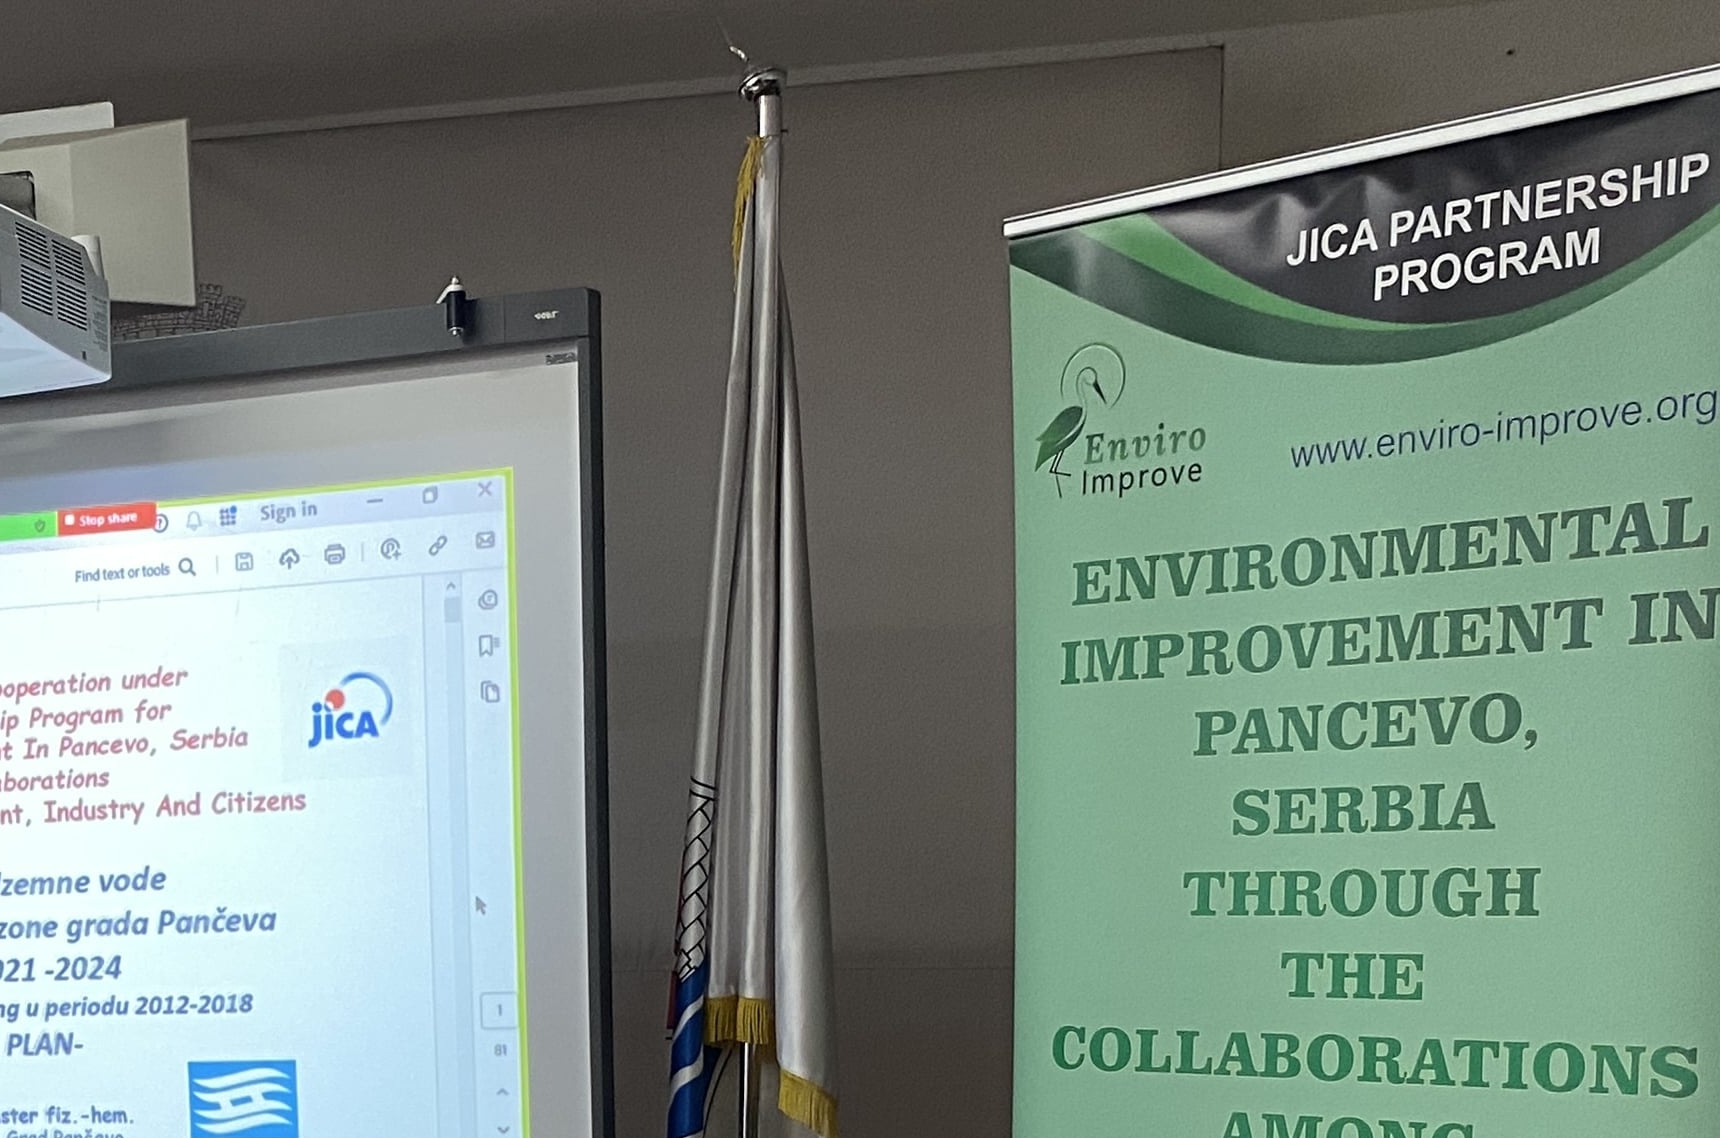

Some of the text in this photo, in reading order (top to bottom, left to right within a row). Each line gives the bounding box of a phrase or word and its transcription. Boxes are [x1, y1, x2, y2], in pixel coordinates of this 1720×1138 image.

[1286, 152, 1711, 267] JICA PARTNERSHIP
[1373, 227, 1601, 301] PROGRAM
[1083, 424, 1207, 467] Enviro
[1291, 388, 1719, 469] www.enviro-improve.org
[1081, 460, 1204, 498] Improve
[79, 511, 138, 528] Stop share
[260, 501, 318, 525] Sign in
[1071, 496, 1710, 606] ENVIRONMENTAL
[75, 563, 170, 583] Find text or tools
[1059, 588, 1720, 685] IMPROVEMENT IN
[121, 665, 188, 690] under
[29, 706, 123, 734] Program
[135, 699, 172, 724] for
[1192, 691, 1539, 757] PANCEVO,
[22, 737, 49, 760] In
[59, 736, 157, 758] Pancevo,
[170, 726, 249, 751] Serbia
[43, 797, 145, 825] Industry
[156, 792, 201, 818] And
[211, 791, 307, 815] Citizens
[1232, 781, 1495, 836] SERBIA
[99, 865, 167, 893] vode
[1183, 867, 1542, 918] THROUGH
[66, 910, 149, 944] grada
[157, 906, 277, 935] Pančeva
[44, 955, 122, 981] -2024
[1280, 952, 1425, 1001] THE
[26, 1002, 39, 1018] u
[44, 995, 129, 1022] periodu
[134, 993, 254, 1016] 2012-2018
[6, 1031, 84, 1057] PLAN-
[1051, 1025, 1699, 1099] COLLABORATIONS
